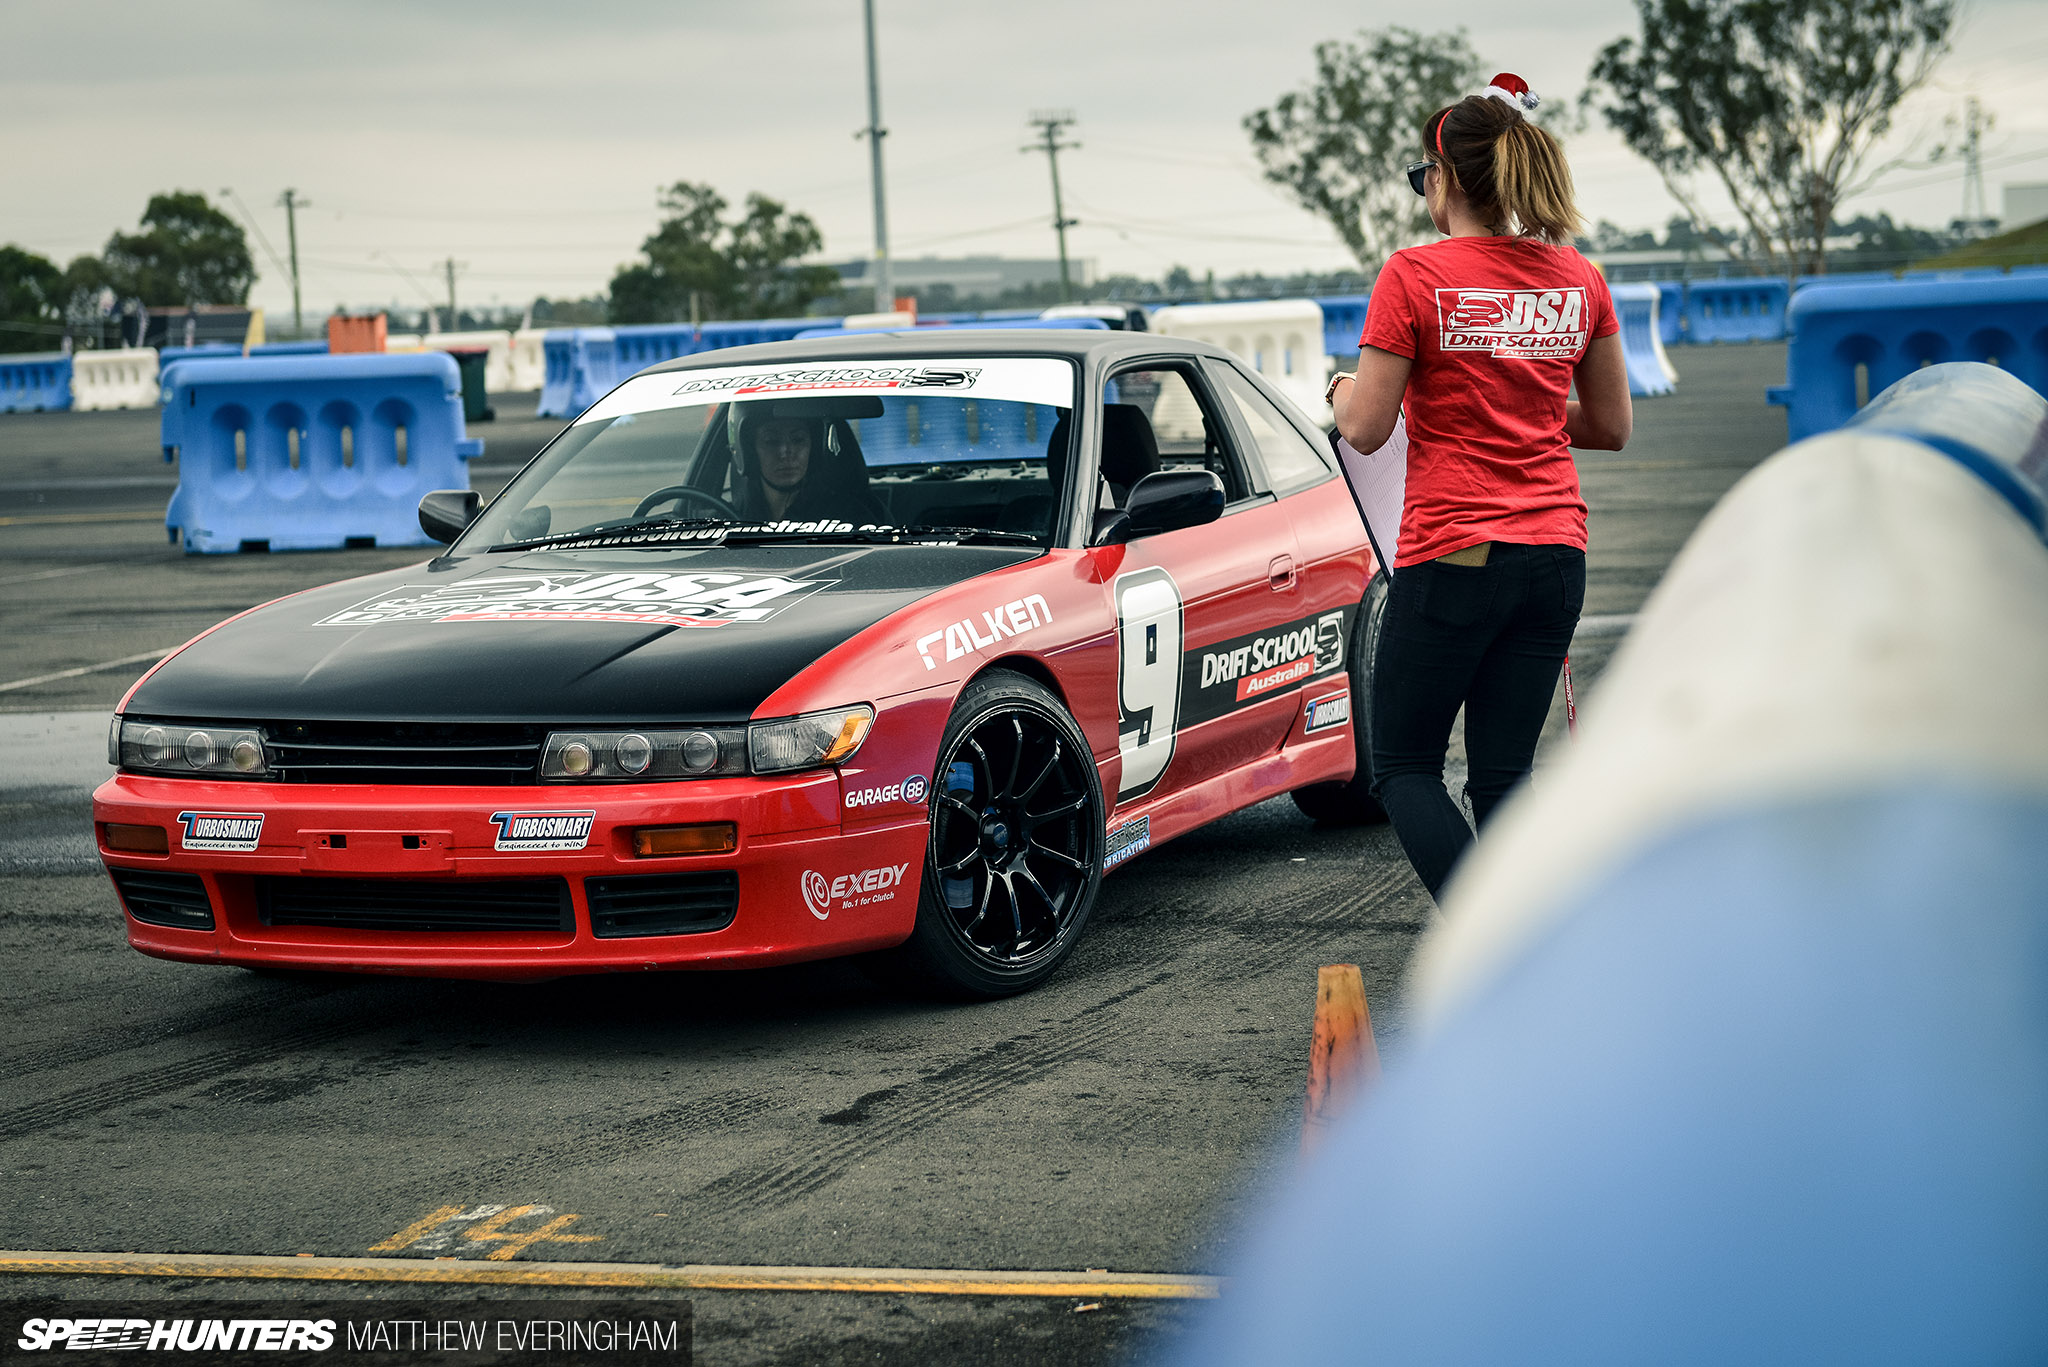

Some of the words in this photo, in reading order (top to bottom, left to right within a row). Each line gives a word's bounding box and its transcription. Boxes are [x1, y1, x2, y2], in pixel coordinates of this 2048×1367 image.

[1507, 291, 1582, 334] DSA
[1503, 349, 1571, 357] Australia
[759, 381, 890, 393] Australia
[548, 572, 817, 608] DSA
[916, 593, 1054, 671] FALKEN
[1114, 566, 1184, 806] 9
[1246, 661, 1310, 694] Australia
[845, 784, 901, 808] GARAGE
[906, 781, 925, 799] 88
[182, 813, 263, 839] TURBOSMART
[495, 812, 594, 838] TURBOSMART
[185, 840, 225, 849] Engineered
[227, 841, 236, 849] to
[498, 841, 548, 850] Engineered
[551, 841, 561, 849] to
[564, 840, 584, 848] WIN
[830, 862, 910, 899] EXEDY
[860, 896, 872, 906] for
[872, 891, 895, 903] Clutch
